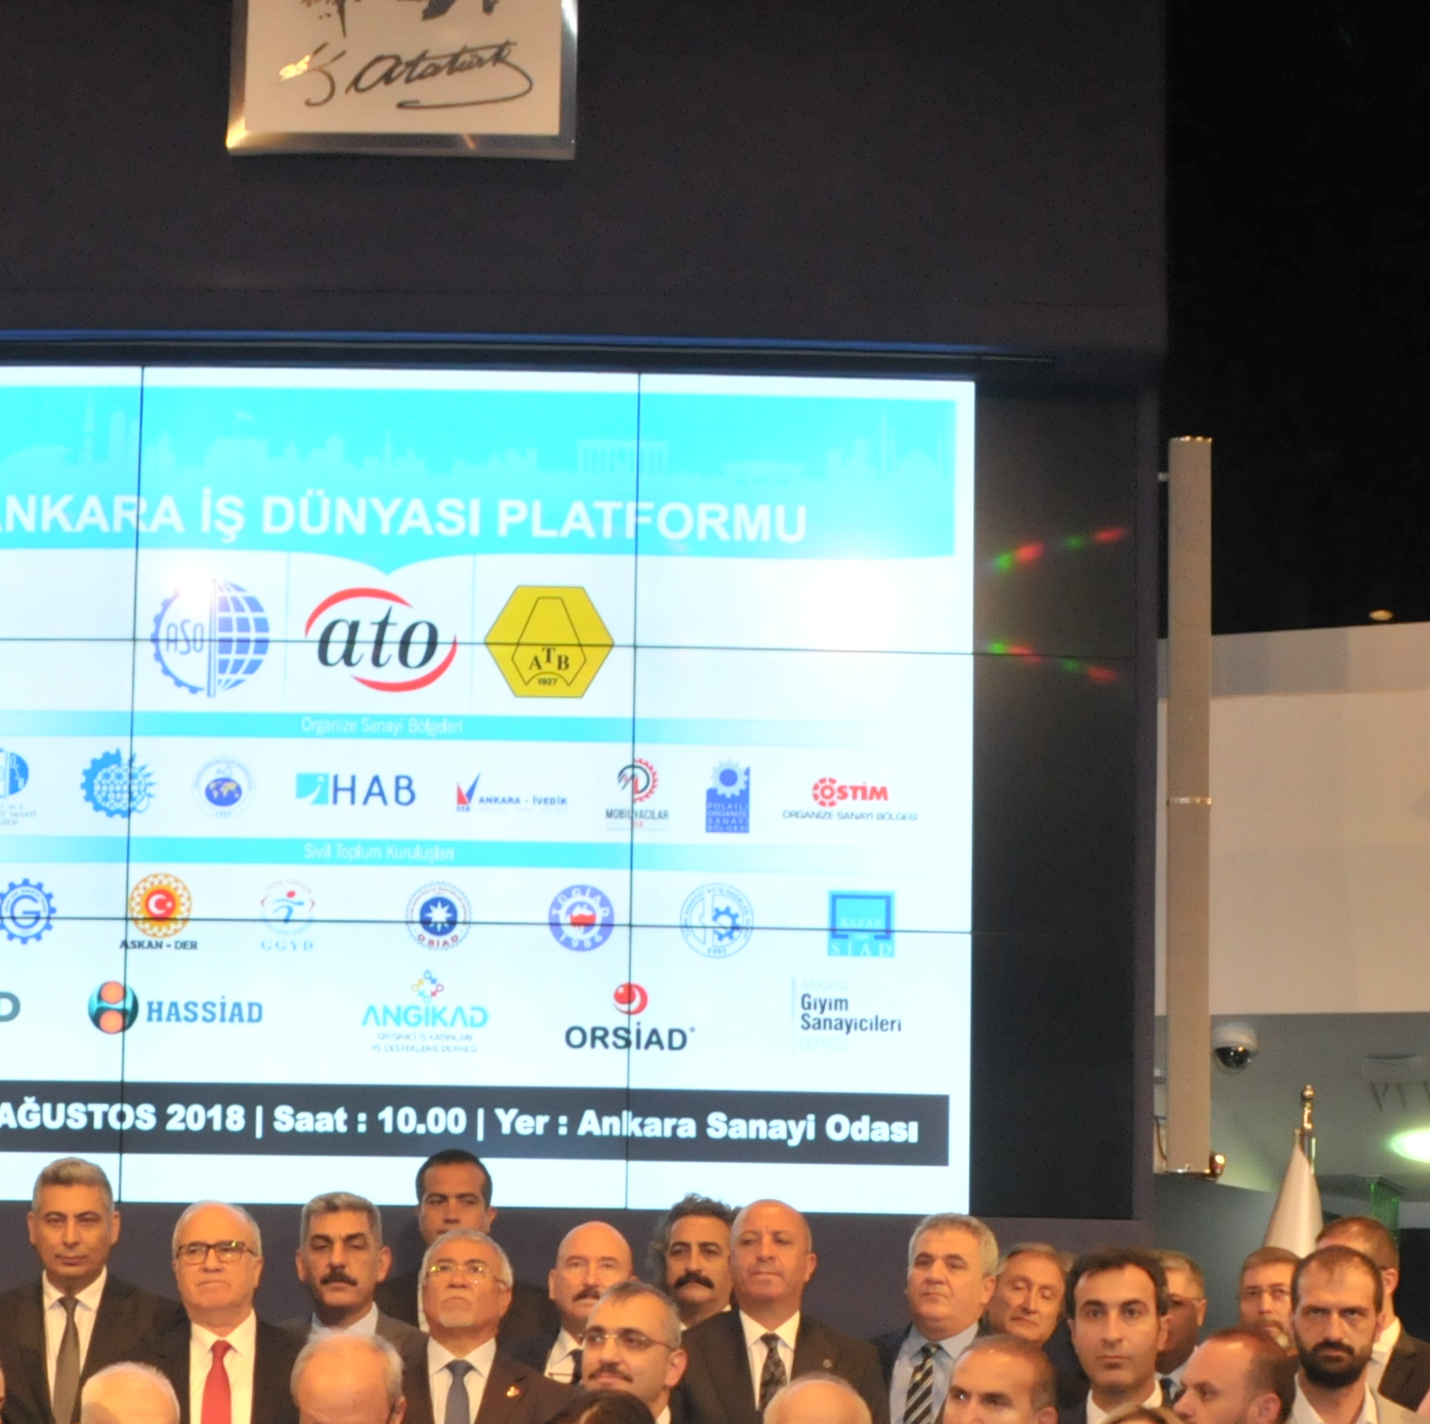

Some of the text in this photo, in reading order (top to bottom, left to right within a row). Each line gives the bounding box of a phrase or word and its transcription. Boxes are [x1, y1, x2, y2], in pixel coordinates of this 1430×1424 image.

[201, 488, 245, 544] İŞ
[262, 489, 481, 537] DÜNYASI
[498, 499, 806, 543] PLATFORMU
[166, 618, 204, 656] ASO
[317, 606, 438, 669] ato
[528, 647, 570, 671] ATB
[537, 677, 559, 687] 1927
[301, 717, 463, 737] Organize Sanayi Bölgeleri
[332, 774, 417, 806] HAB
[478, 796, 521, 804] ANKARA
[532, 794, 568, 805] İVEDİK
[782, 809, 834, 820] ORGANİZE
[837, 810, 874, 821] SANAYİ
[304, 843, 331, 859] Sivil
[335, 843, 382, 862] Toplum
[119, 940, 163, 950] ASKAN
[173, 940, 199, 950] DER
[145, 995, 263, 1024] HASSİAD
[564, 1021, 688, 1052] ORSİAD
[165, 1104, 246, 1132] 2018
[273, 1105, 348, 1132] Saat
[378, 1106, 467, 1134] 10.00
[495, 1108, 550, 1135] Yer
[577, 1110, 697, 1138] Ankara
[707, 1112, 815, 1146] Sanayi
[826, 1114, 919, 1143] Odası
